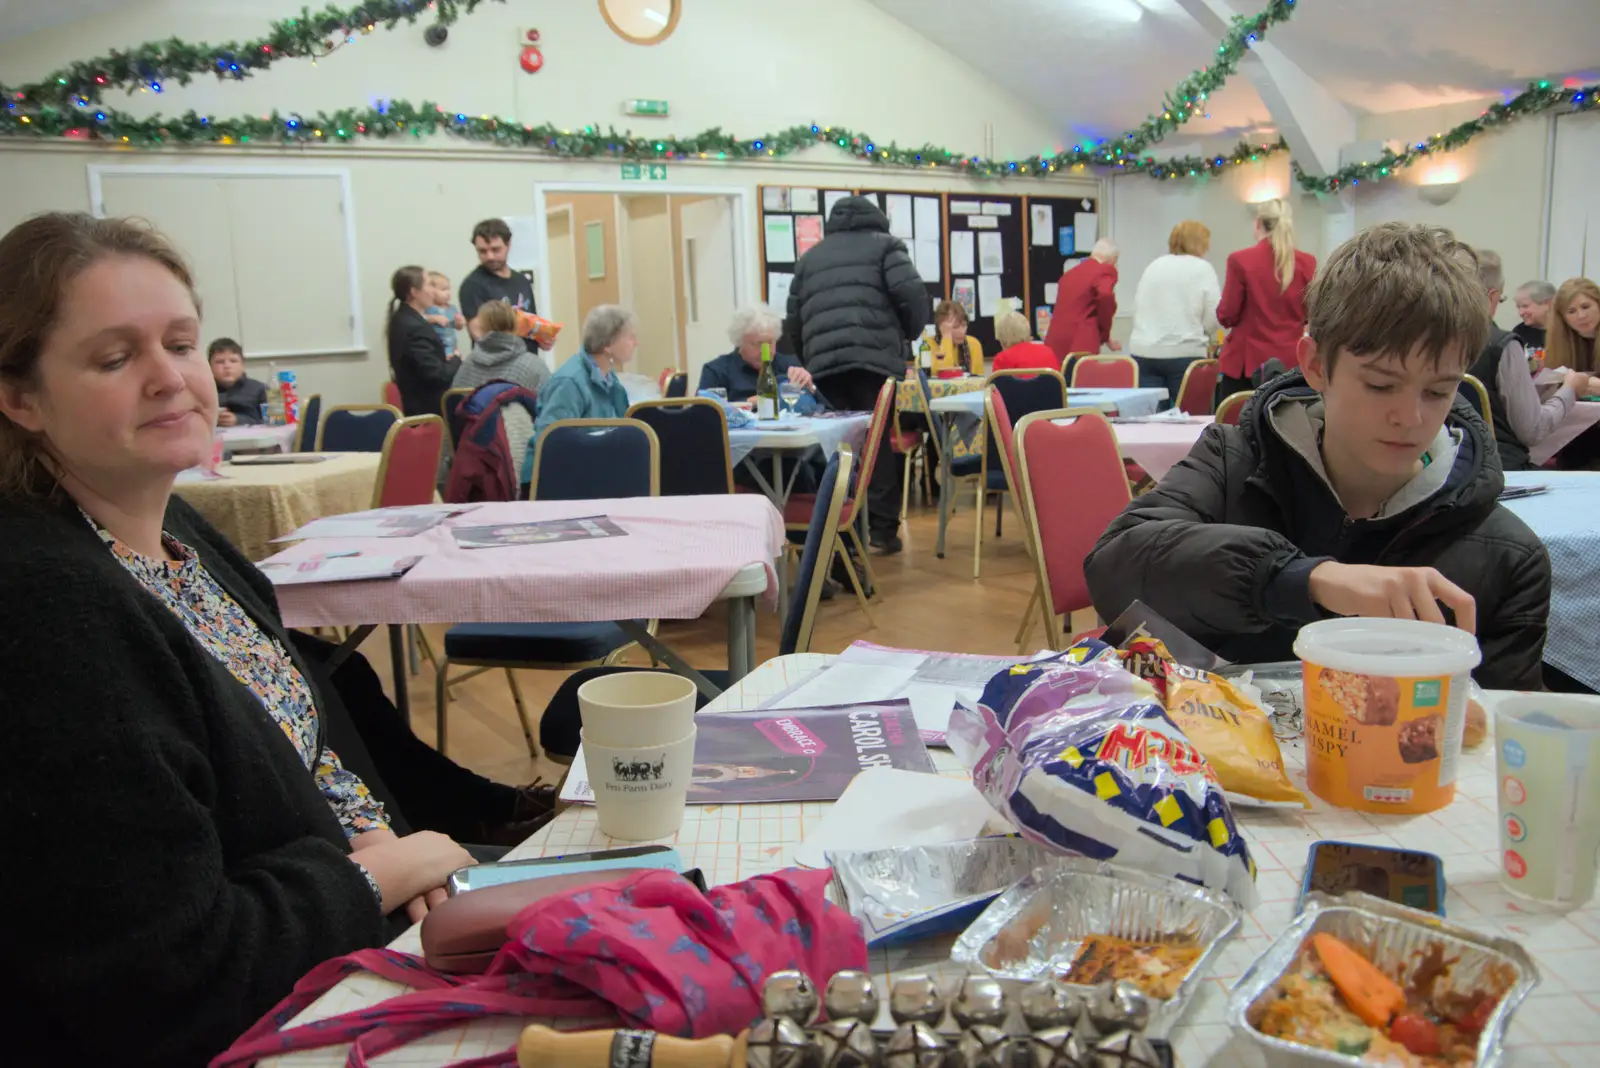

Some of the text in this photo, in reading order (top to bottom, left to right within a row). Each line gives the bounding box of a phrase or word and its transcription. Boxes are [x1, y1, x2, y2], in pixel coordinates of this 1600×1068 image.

[775, 718, 817, 750] EMBRACE
[848, 710, 887, 753] CAROL
[623, 784, 648, 792] Farm
[650, 780, 673, 791] Dairy
